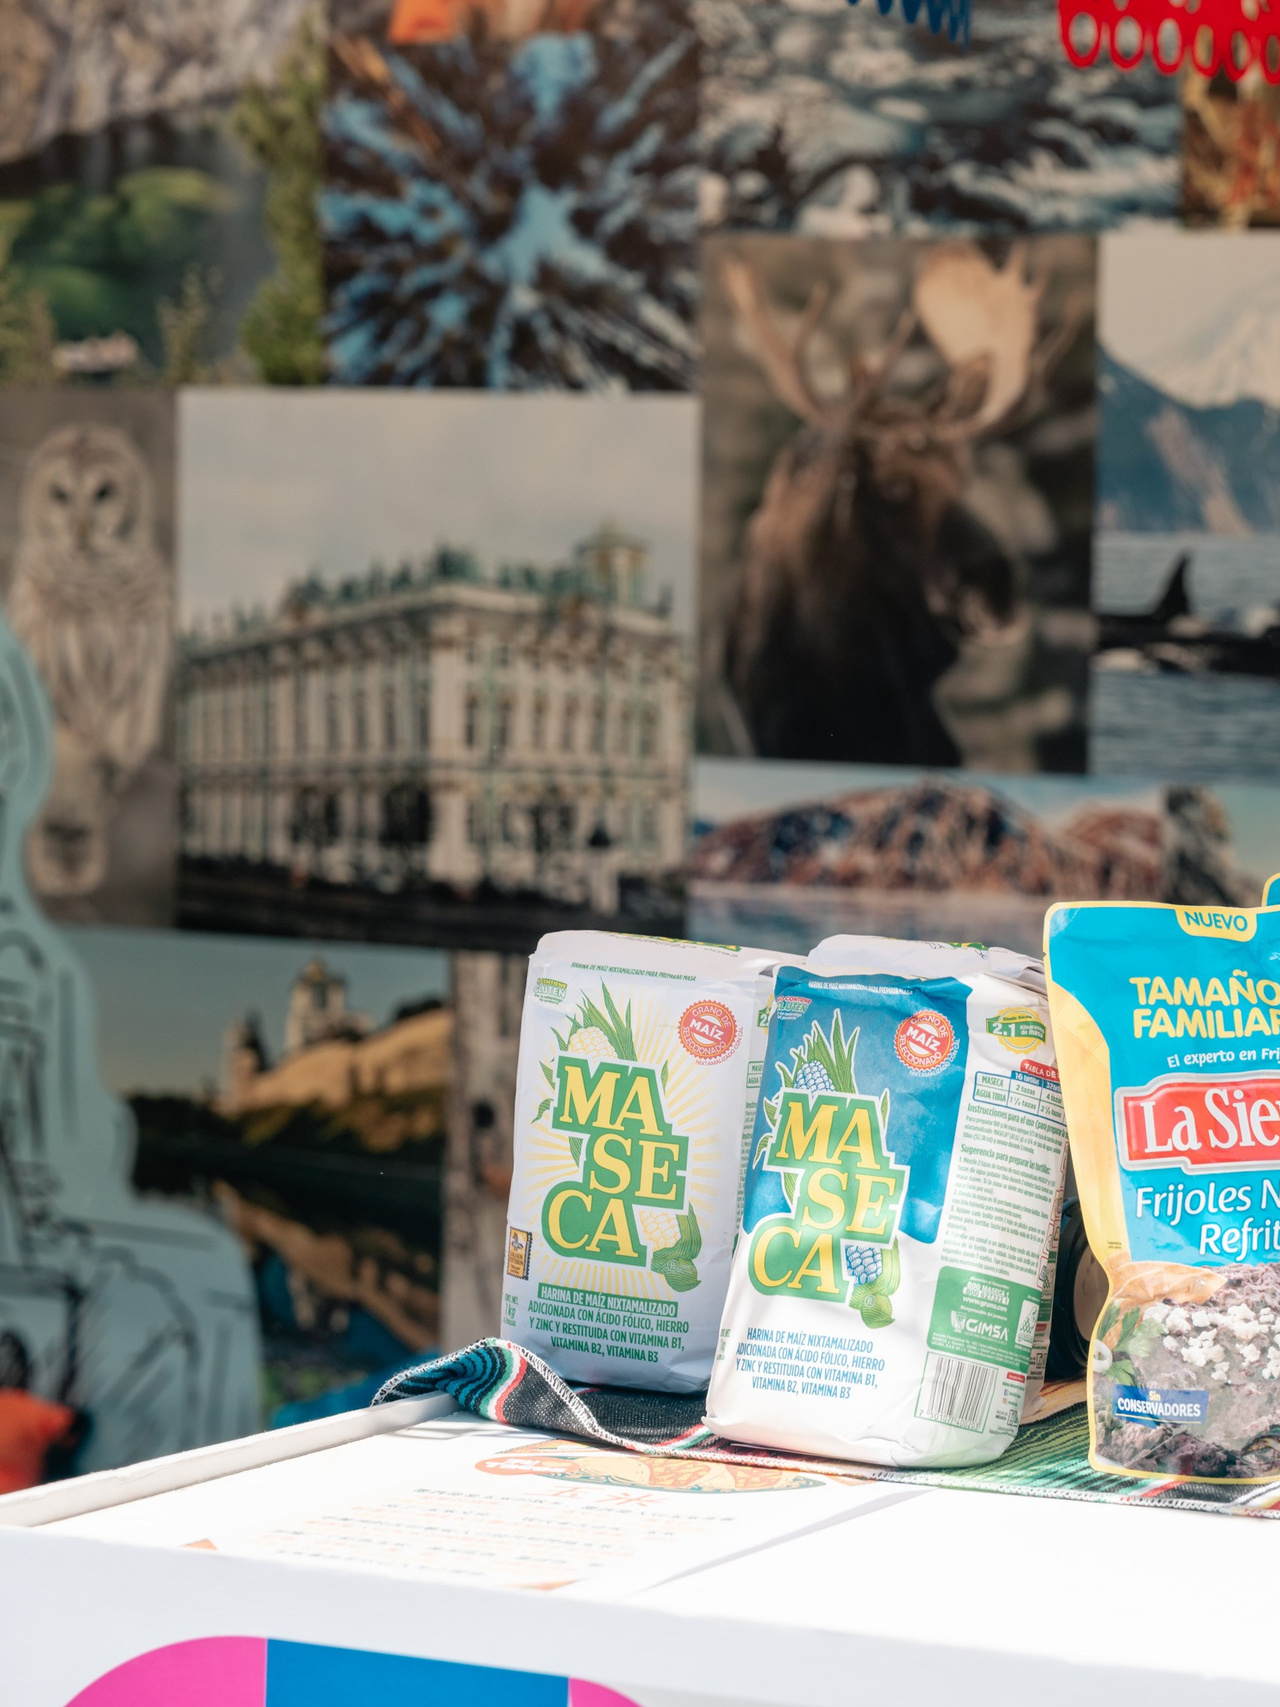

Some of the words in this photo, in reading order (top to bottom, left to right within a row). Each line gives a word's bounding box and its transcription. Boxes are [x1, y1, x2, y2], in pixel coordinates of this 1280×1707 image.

[1185, 911, 1248, 931] NUEVO
[692, 1006, 723, 1016] GRANO
[721, 1015, 731, 1028] DE
[683, 1026, 726, 1054] SELECCIONADO
[690, 1018, 724, 1041] MAÍZ
[906, 1026, 941, 1052] MAÍZ
[938, 1025, 948, 1038] DE
[992, 1022, 1016, 1037] 2.1
[900, 1034, 942, 1066] SELECCIONADO
[1167, 1055, 1179, 1068] El
[1184, 1050, 1235, 1068] experto
[1239, 1048, 1256, 1061] en
[1024, 1063, 1044, 1076] TABLA
[1046, 1070, 1056, 1078] DE
[976, 1088, 992, 1099] AGUA
[982, 1075, 1004, 1088] MASECA
[1020, 1085, 1036, 1096] tazas
[968, 1103, 1008, 1120] Instrucciones
[1140, 1101, 1202, 1153] La
[960, 1143, 995, 1160] Sugerencia
[1136, 1182, 1252, 1226] Frijoles
[541, 1285, 571, 1303] HARINA
[573, 1292, 584, 1305] DE
[585, 1292, 606, 1308] MAÍZ
[607, 1296, 676, 1317] NIXTAMALIZADO
[528, 1300, 576, 1320] ADICIONADA
[578, 1308, 594, 1322] CON
[595, 1308, 620, 1326] ÁCIDO
[623, 1312, 653, 1332] FÓLICO,
[656, 1319, 689, 1334] HIERRO
[529, 1317, 535, 1328] Y
[536, 1318, 554, 1332] ZINC
[555, 1321, 561, 1333] Y
[562, 1322, 608, 1341] RESTITUIDA
[610, 1329, 626, 1344] CON
[629, 1332, 670, 1349] VITAMINA
[671, 1336, 685, 1351] B1,
[747, 1328, 774, 1342] HARINA
[776, 1330, 786, 1344] DE
[786, 1330, 807, 1346] MAÍZ
[808, 1334, 874, 1354] NIXTAMALIZADO
[966, 1318, 1008, 1342] GIMSA
[550, 1336, 590, 1353] VITAMINA
[591, 1344, 604, 1357] B2,
[606, 1344, 645, 1361] VITAMINA
[647, 1351, 658, 1363] B3
[736, 1342, 776, 1358] ADICIONADA
[778, 1346, 793, 1360] CON
[794, 1346, 819, 1364] ÁCIDO
[820, 1350, 849, 1369] FÓLICO,
[852, 1356, 886, 1371] HIERRO
[736, 1358, 741, 1371] Y
[741, 1358, 756, 1372] ZINC
[758, 1360, 762, 1372] Y
[763, 1362, 805, 1378] RESTITUIDA
[806, 1366, 822, 1380] CON
[824, 1368, 863, 1384] VITAMINA
[865, 1374, 878, 1390] B1,
[752, 1376, 786, 1392] VITAMINA
[787, 1380, 799, 1396] B2,
[801, 1382, 838, 1398] VITAMINA
[839, 1386, 852, 1399] B3
[1149, 1391, 1161, 1401] Sin
[1117, 1399, 1201, 1418] CONSERVADORES
